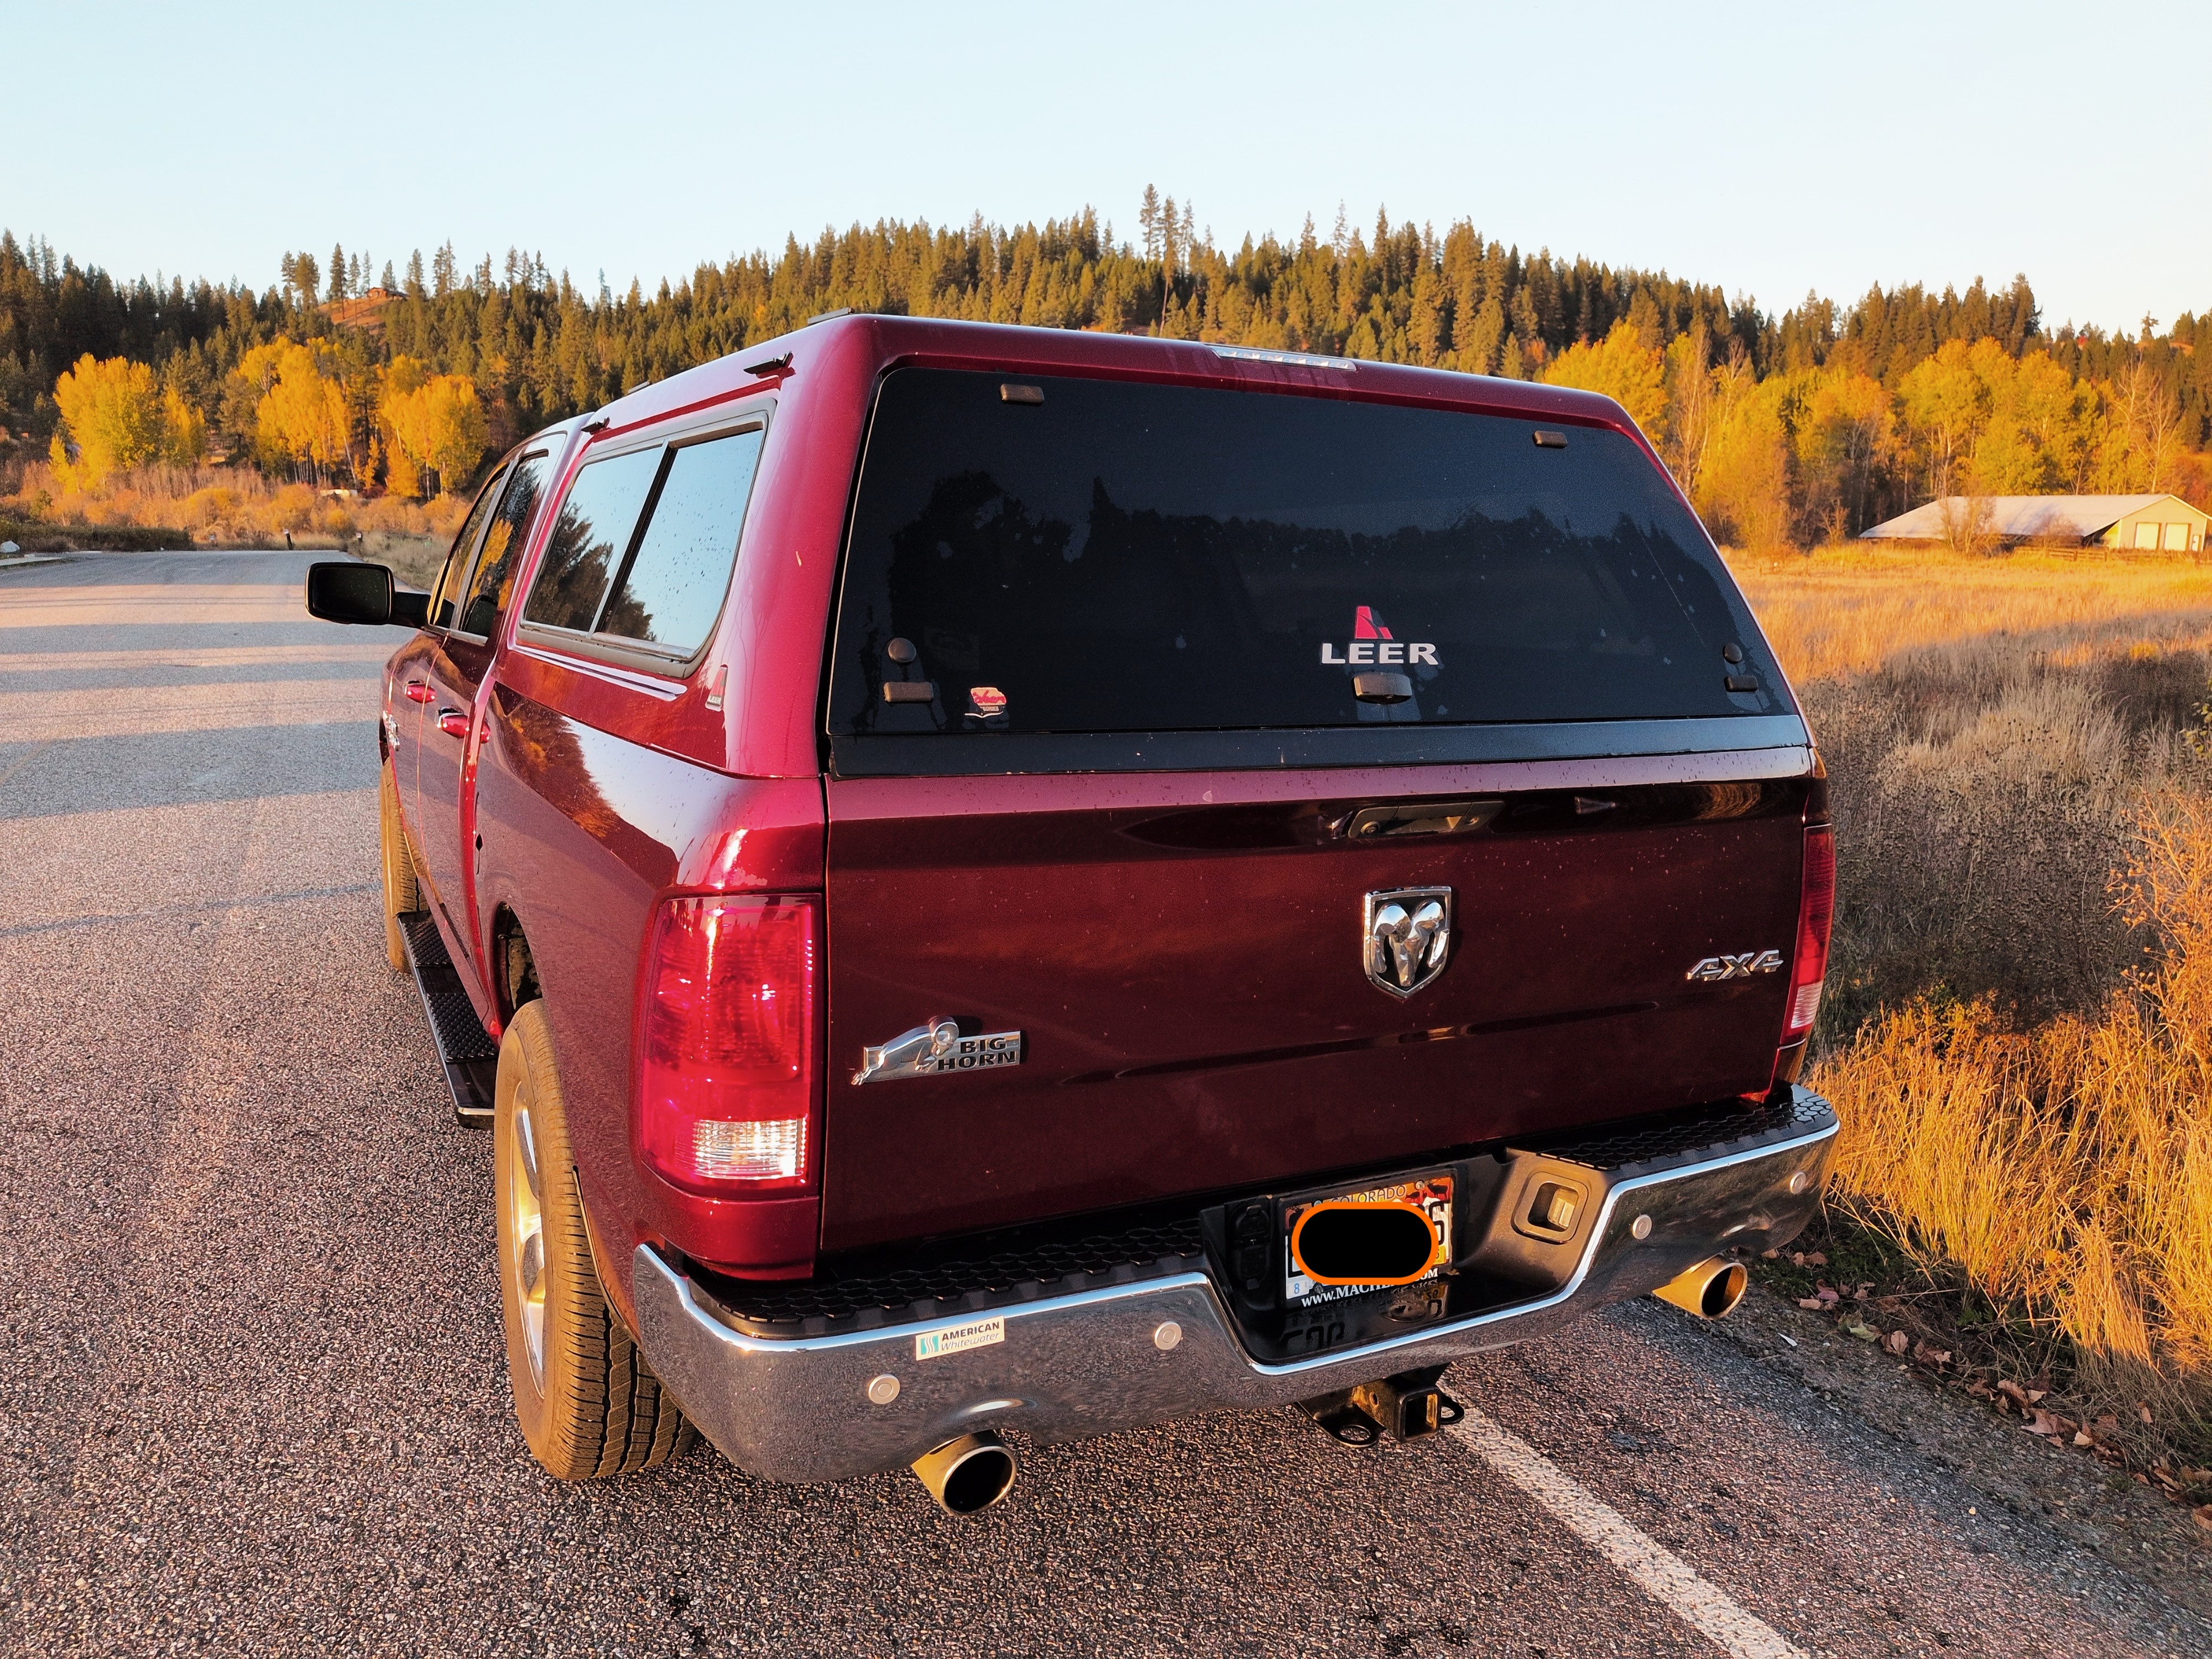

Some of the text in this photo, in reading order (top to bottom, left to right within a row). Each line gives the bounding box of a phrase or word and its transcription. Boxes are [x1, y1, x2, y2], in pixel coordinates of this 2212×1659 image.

[1321, 643, 1439, 665] LEER
[959, 1037, 1007, 1055] BIG
[937, 1050, 1016, 1072] HORN
[1293, 1282, 1300, 1295] 8
[941, 1321, 1000, 1342] AMERICAN
[941, 1332, 1000, 1352] Whitewater
